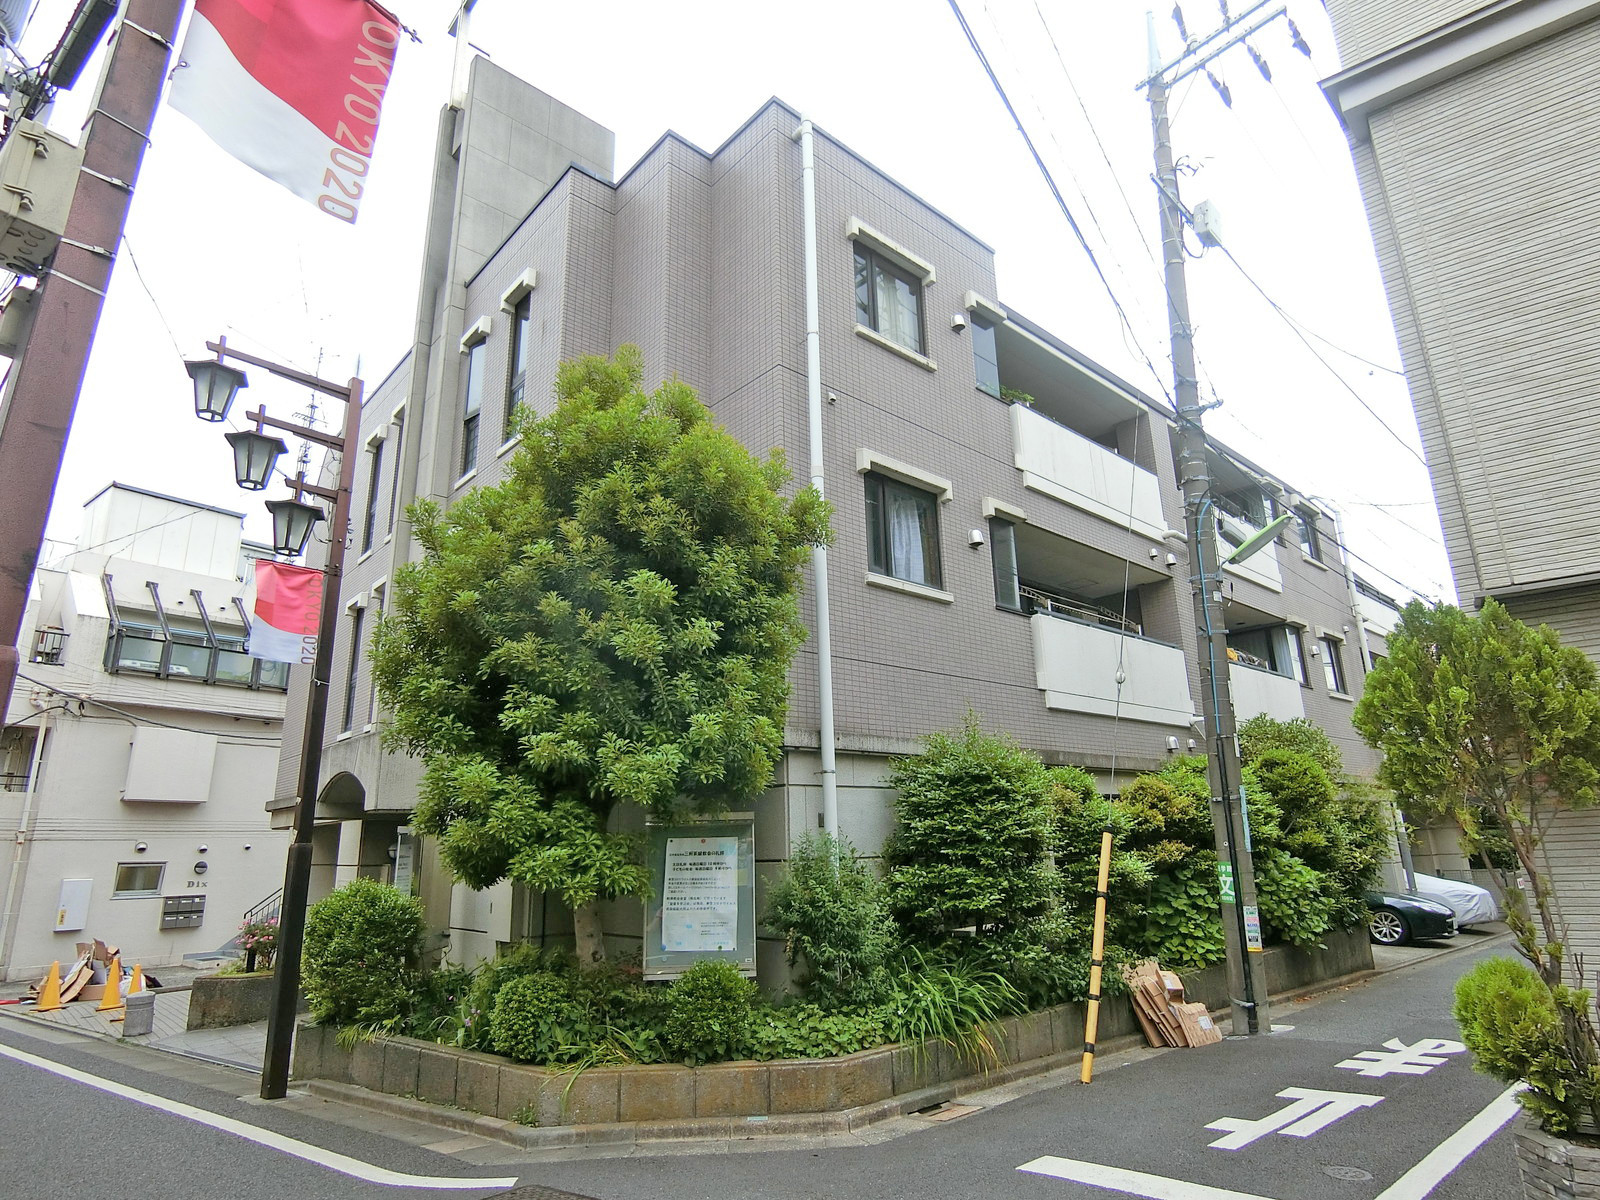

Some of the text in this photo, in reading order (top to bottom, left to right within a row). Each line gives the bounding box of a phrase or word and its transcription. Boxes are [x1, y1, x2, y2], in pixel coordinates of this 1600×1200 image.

[318, 20, 398, 224] OKYO 2020
[300, 577, 324, 665] OKYO 2020
[1218, 874, 1235, 896] 文
